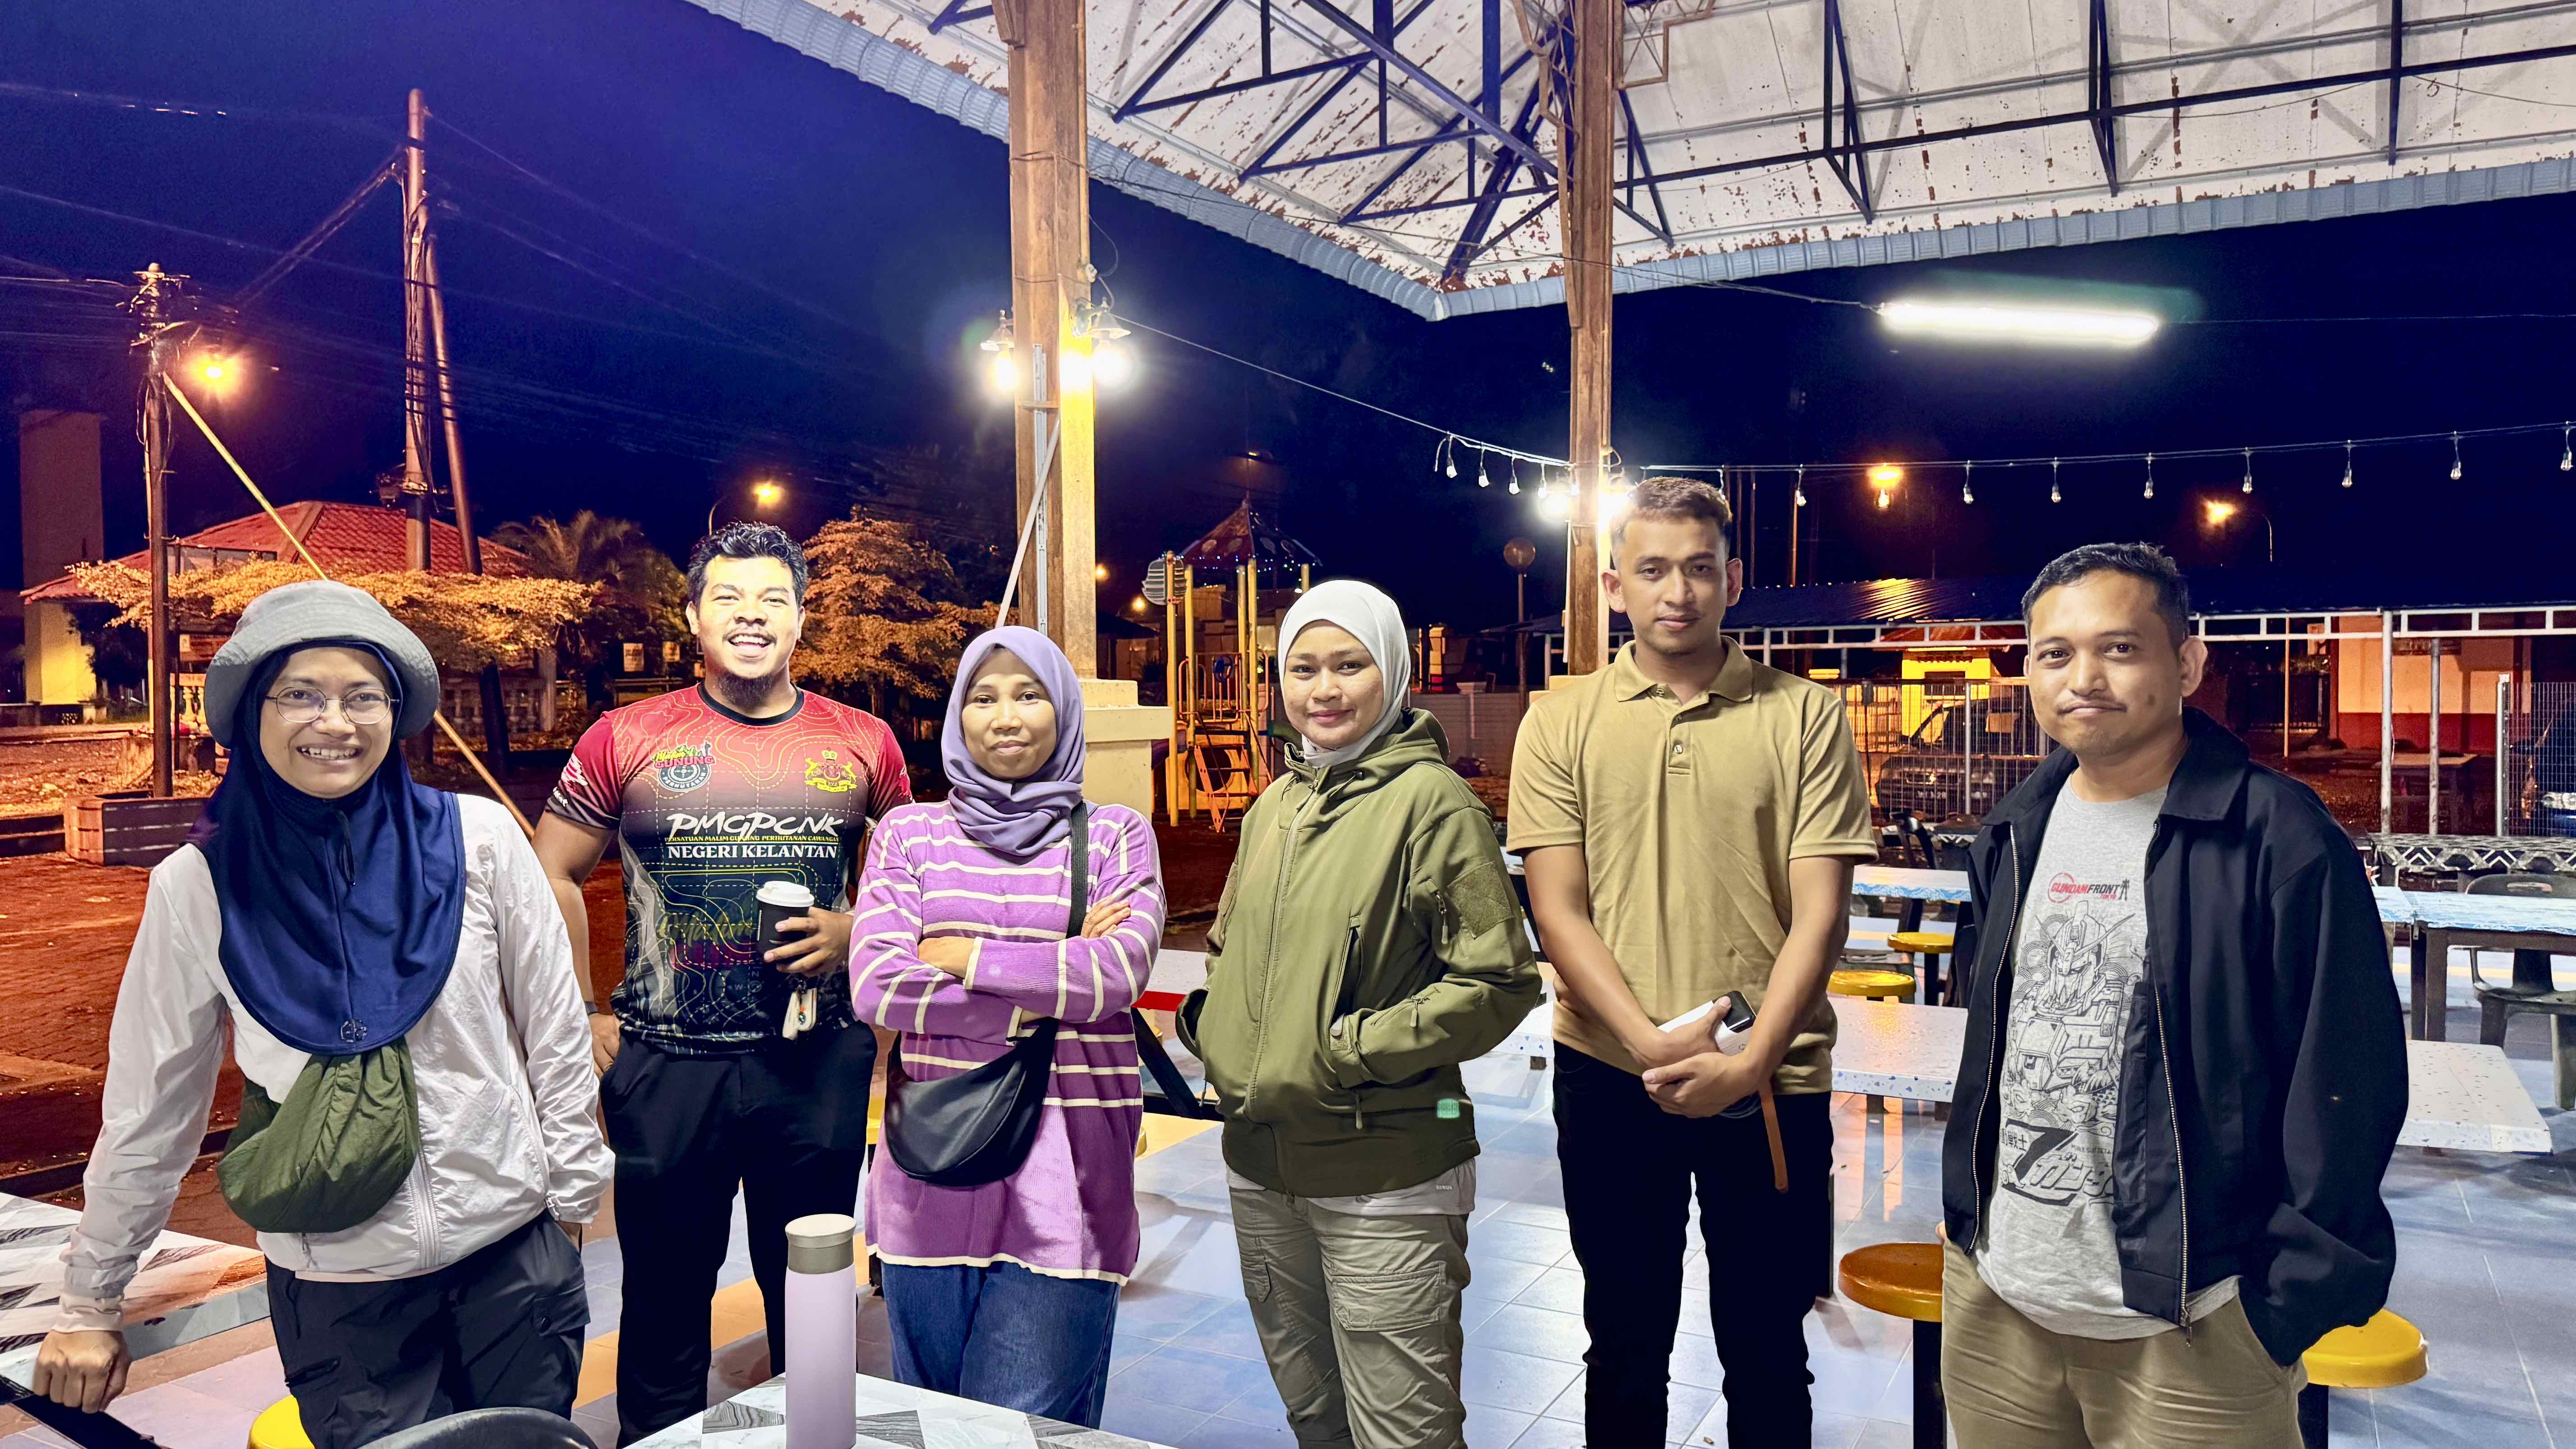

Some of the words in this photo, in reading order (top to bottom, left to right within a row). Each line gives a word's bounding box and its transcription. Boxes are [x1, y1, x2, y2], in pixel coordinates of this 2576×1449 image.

[654, 755, 715, 768] GUNUNG
[666, 811, 844, 842] PMGPCNK
[667, 845, 738, 859] NEGERI
[742, 845, 837, 859] KELANTAN
